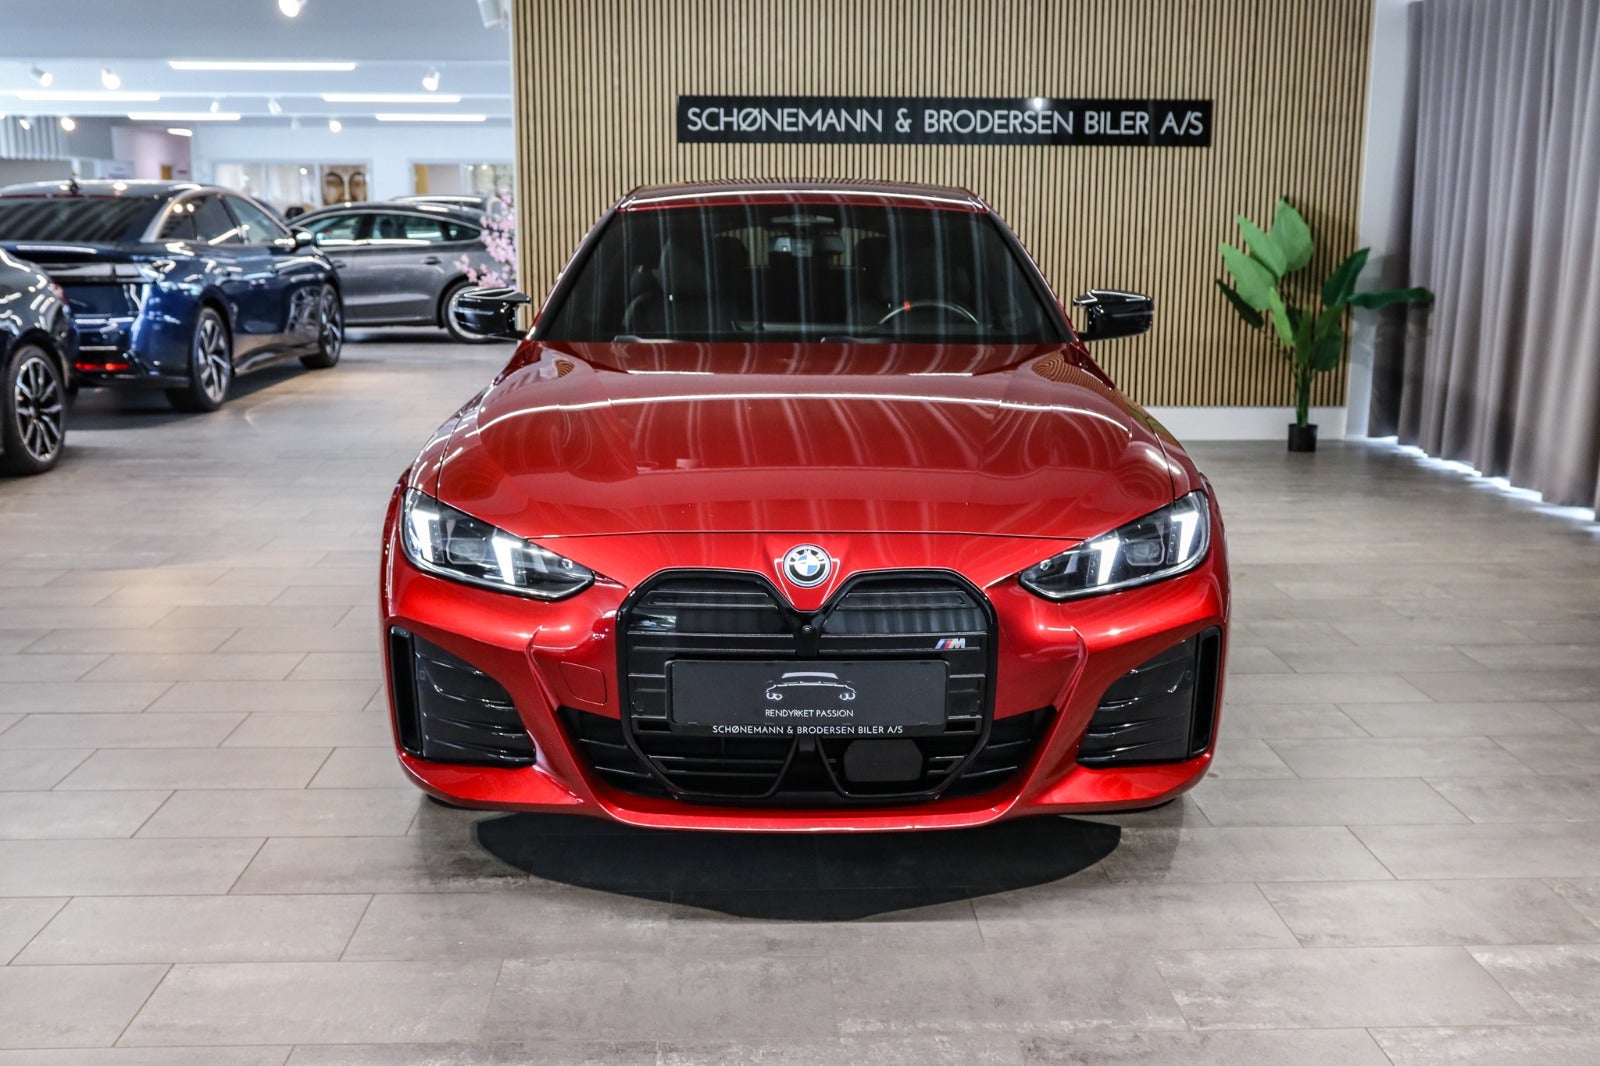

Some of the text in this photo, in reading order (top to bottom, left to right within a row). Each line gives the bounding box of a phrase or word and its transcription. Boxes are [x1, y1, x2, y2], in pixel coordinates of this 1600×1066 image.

[687, 107, 1203, 135] SCHØNEMANN & BRODERSEN BILER A/S
[765, 709, 854, 718] RENDYRKET PASSION
[712, 725, 903, 735] SCHØNEMANN & BRODERSEN BILER A/S
